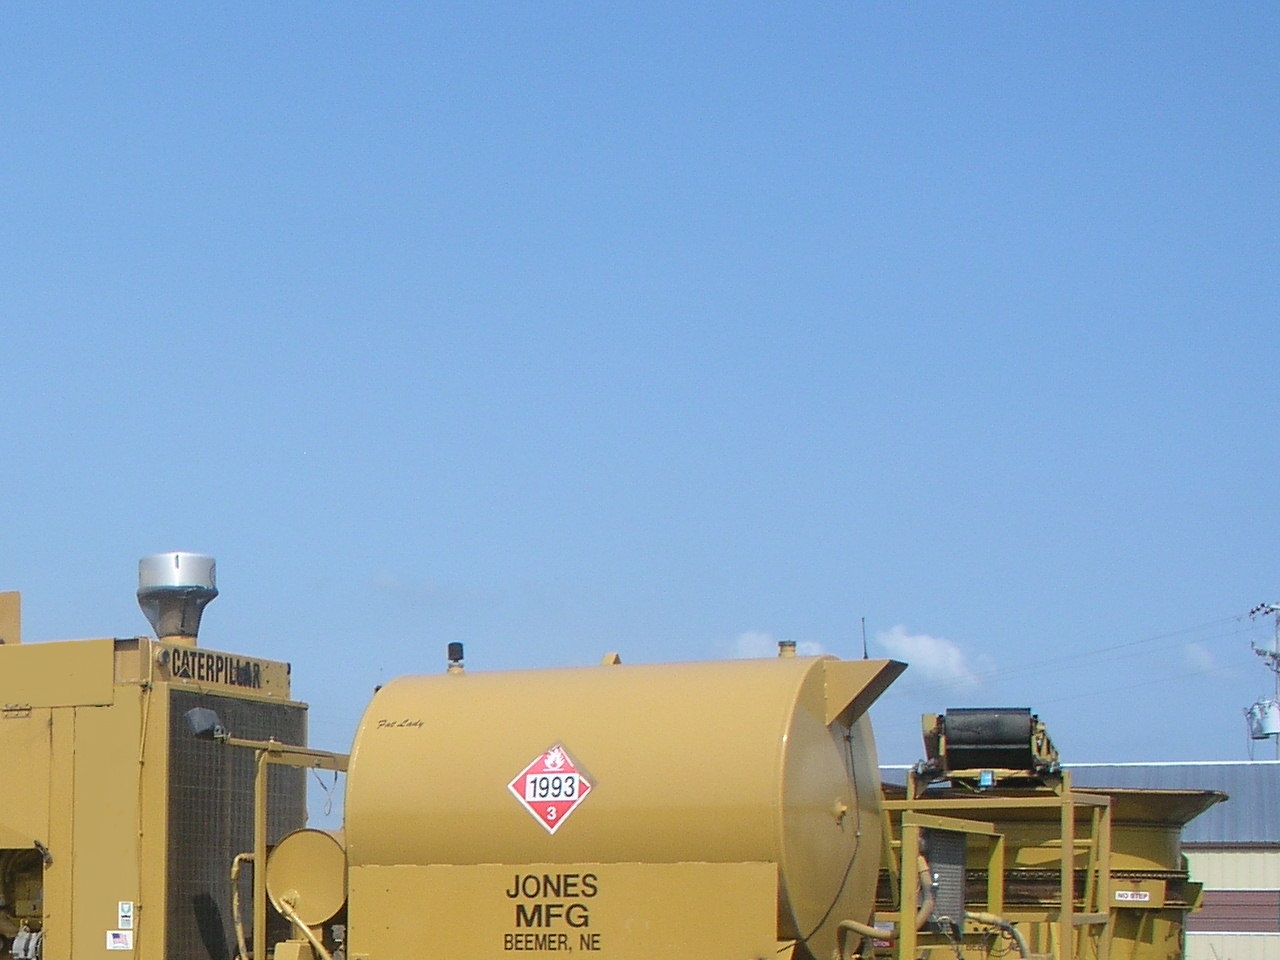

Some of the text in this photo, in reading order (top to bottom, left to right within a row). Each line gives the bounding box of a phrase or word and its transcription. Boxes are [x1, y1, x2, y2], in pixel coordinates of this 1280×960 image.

[171, 648, 262, 689] CATERPILLAR
[530, 776, 575, 798] 1993
[546, 806, 557, 820] 3
[506, 874, 598, 898] JONES
[516, 904, 589, 928] MFG
[504, 934, 601, 953] BEEMER, NE
